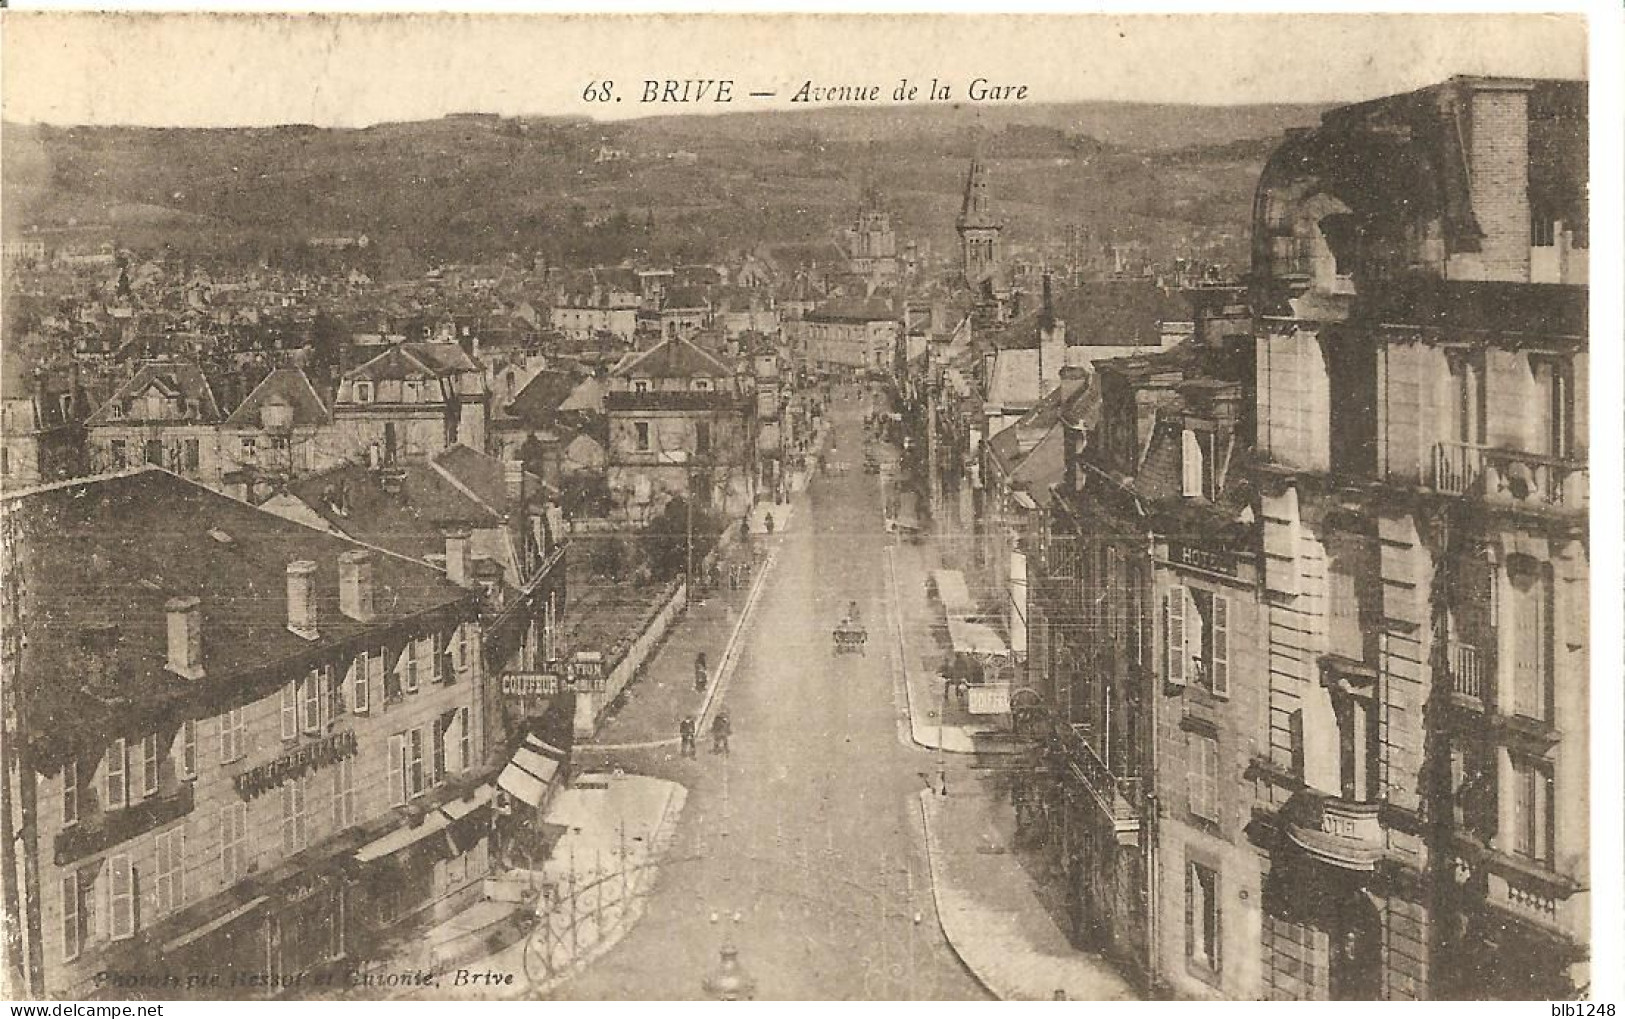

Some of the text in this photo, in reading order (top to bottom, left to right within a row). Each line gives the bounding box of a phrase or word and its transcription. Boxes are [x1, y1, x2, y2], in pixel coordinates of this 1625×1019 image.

[1181, 547, 1229, 572] HOTEL
[502, 674, 559, 695] COIFFEUR
[1321, 813, 1364, 841] OTEL
